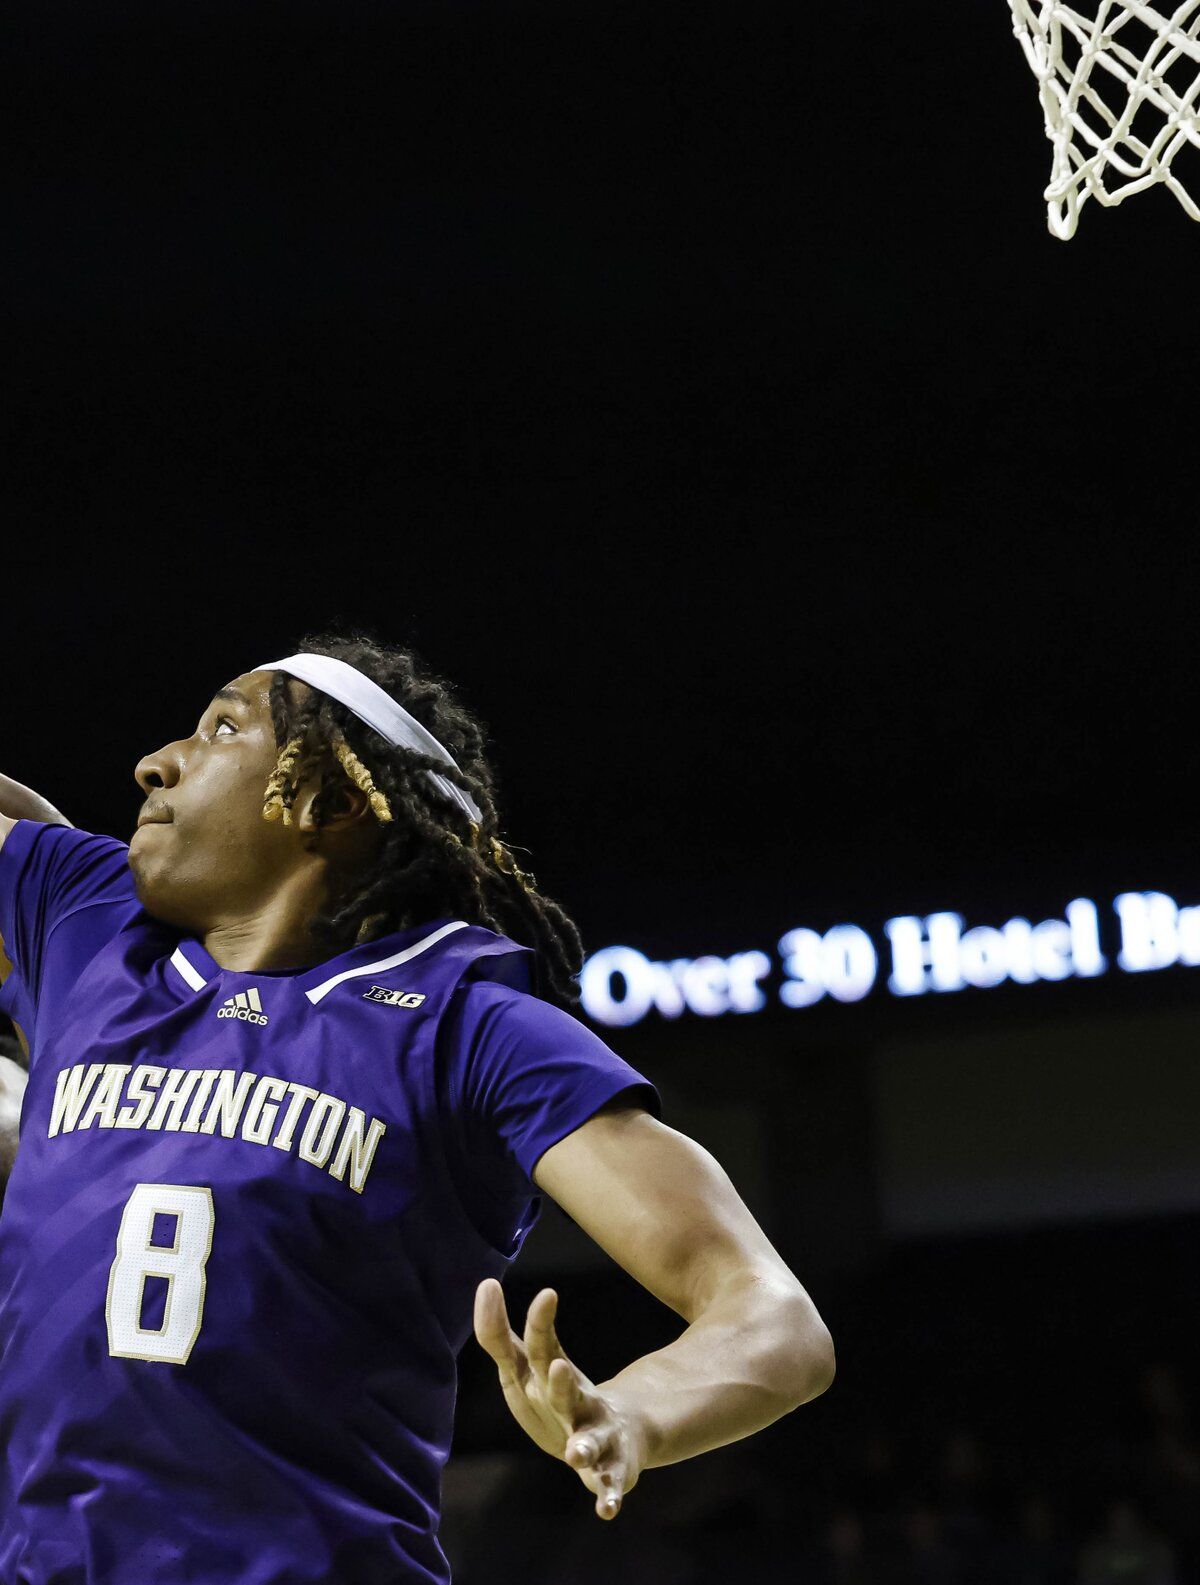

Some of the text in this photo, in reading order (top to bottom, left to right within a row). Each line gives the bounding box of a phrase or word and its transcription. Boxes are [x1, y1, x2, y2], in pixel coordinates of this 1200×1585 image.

[216, 1003, 268, 1026] adidas
[580, 945, 771, 1028] Over
[777, 923, 876, 1009] 30
[884, 896, 1106, 997] Hotel
[47, 1063, 387, 1195] WASHINGTON
[105, 1183, 216, 1366] 8
